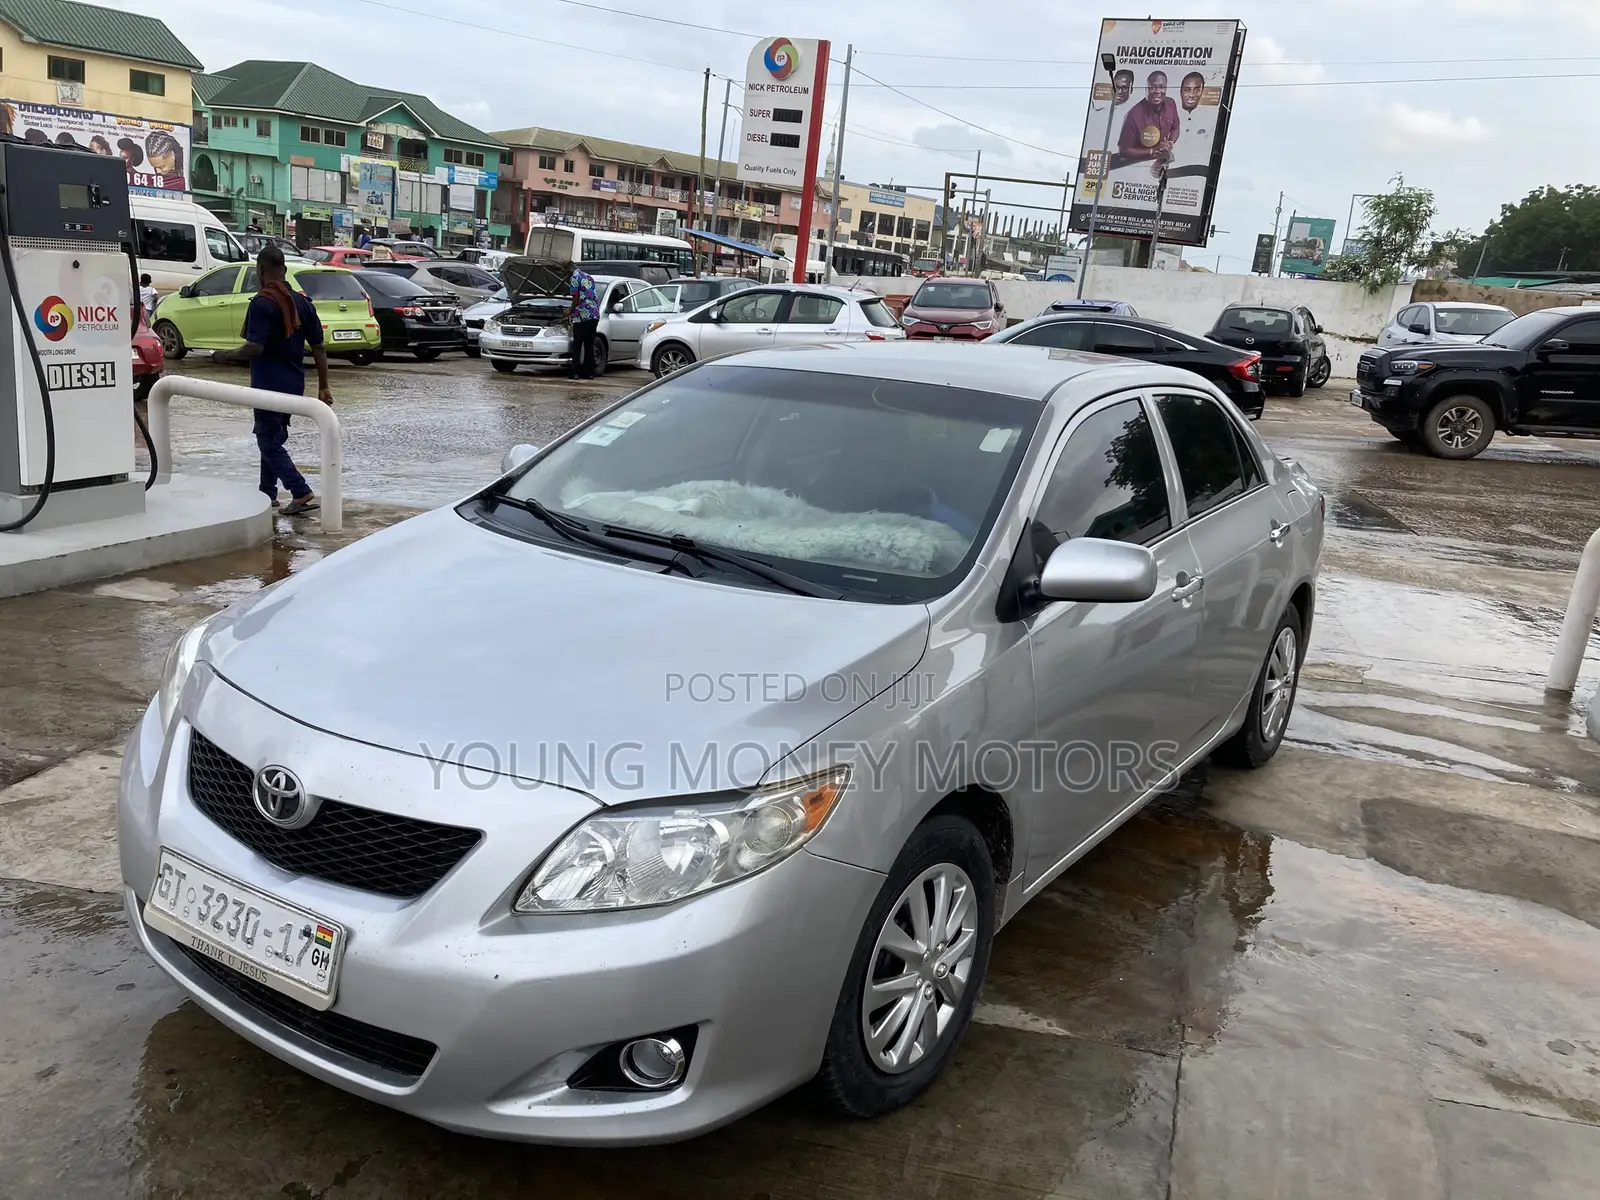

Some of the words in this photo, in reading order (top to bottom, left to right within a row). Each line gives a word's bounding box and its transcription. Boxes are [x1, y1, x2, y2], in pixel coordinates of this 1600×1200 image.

[1116, 45, 1213, 59] INAUGURATION
[1145, 58, 1173, 66] CHURCH
[748, 83, 765, 92] NICK
[766, 84, 809, 95] PETROLEUM
[20, 113, 53, 122] Permanent
[56, 117, 84, 126] Temporal
[749, 108, 771, 119] SUPER
[746, 132, 769, 143] DIESEL
[1090, 153, 1108, 161] 14T
[744, 164, 764, 173] Quality
[766, 165, 782, 174] Fuels
[783, 167, 797, 176] Only
[133, 172, 148, 187] 64
[151, 175, 164, 188] 18
[1112, 183, 1122, 197] 3
[1137, 188, 1156, 196] NIGH
[1123, 193, 1157, 203] SERVICES
[1107, 214, 1128, 222] PRAYER
[77, 306, 118, 322] NICK
[77, 323, 119, 332] PETROLEUM
[48, 362, 115, 389] DIESEL
[157, 862, 187, 907] GT
[197, 883, 315, 967] 3230-17
[191, 935, 225, 962] THANK
[228, 956, 235, 966] U
[237, 960, 268, 984] JESUS
[311, 948, 330, 971] GH
